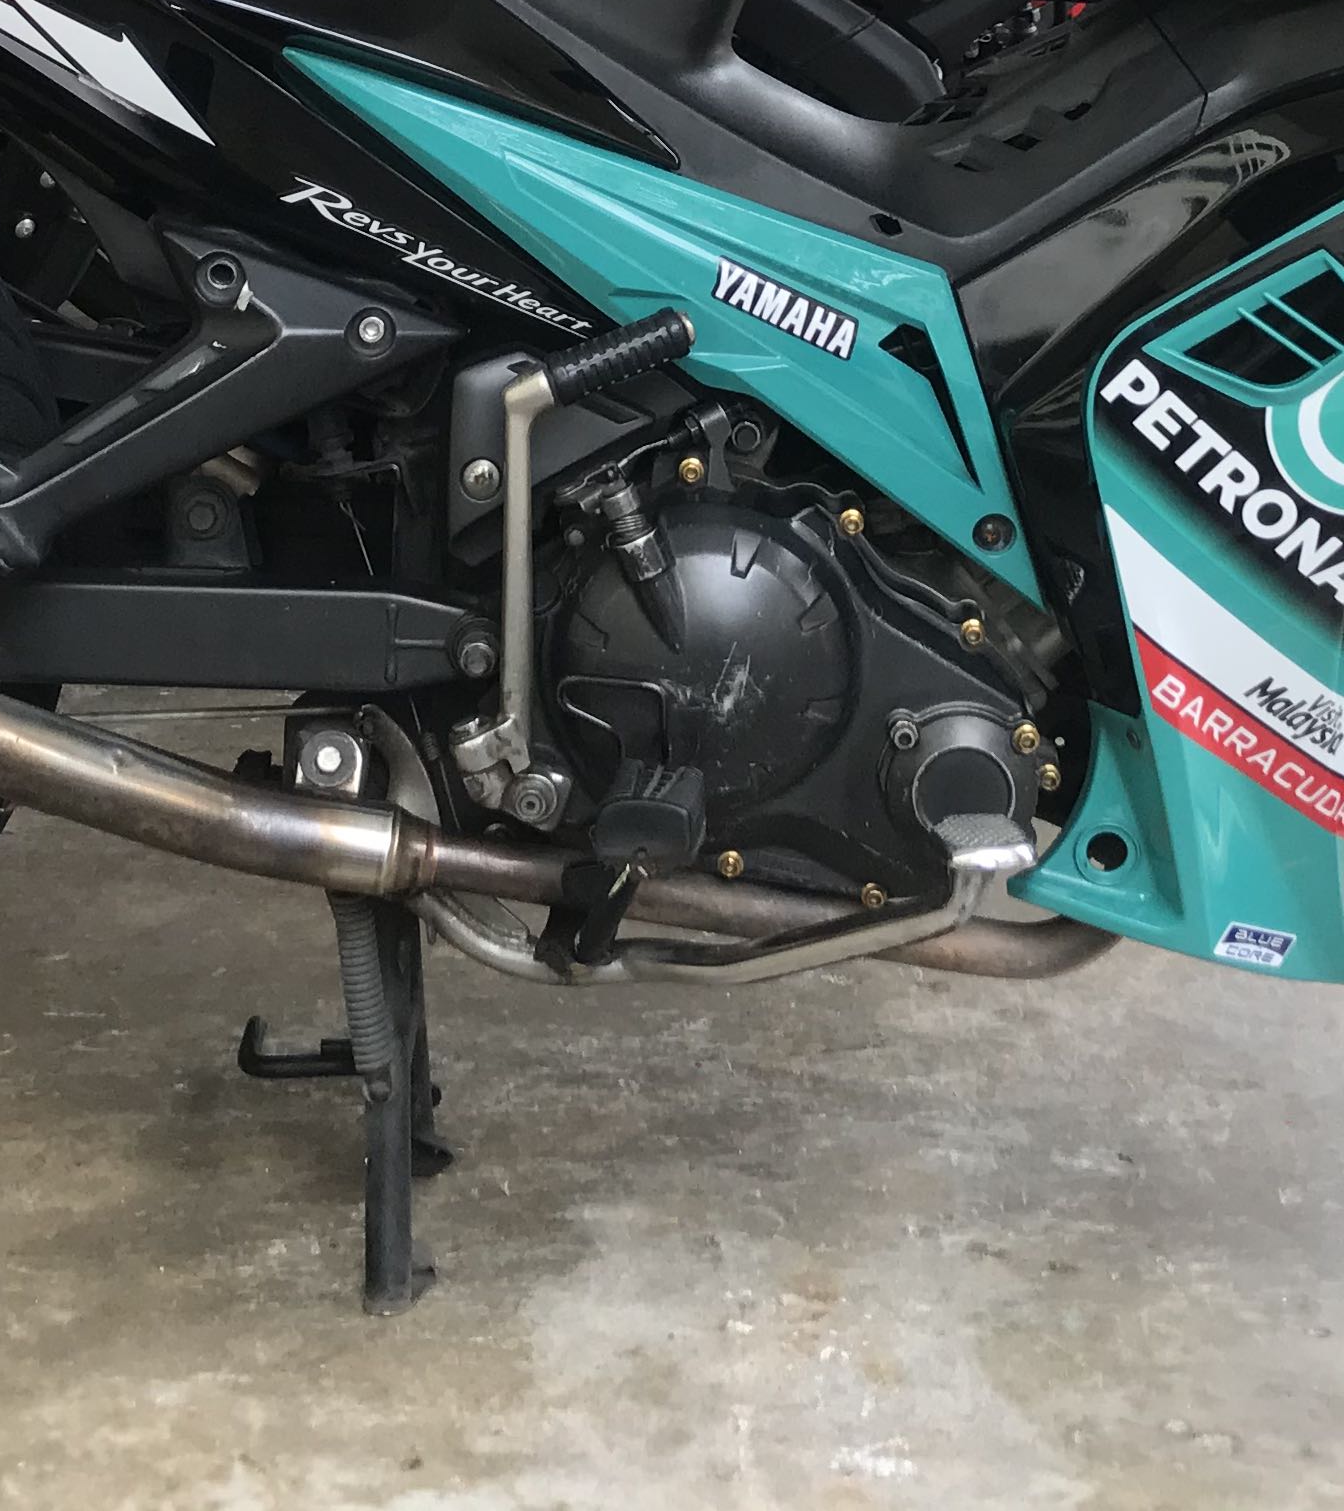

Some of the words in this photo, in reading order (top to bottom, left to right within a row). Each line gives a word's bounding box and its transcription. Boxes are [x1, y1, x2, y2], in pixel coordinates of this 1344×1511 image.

[279, 176, 415, 246] Revs
[401, 241, 499, 287] Your
[495, 283, 593, 332] Heart
[714, 256, 856, 359] YAMAHA
